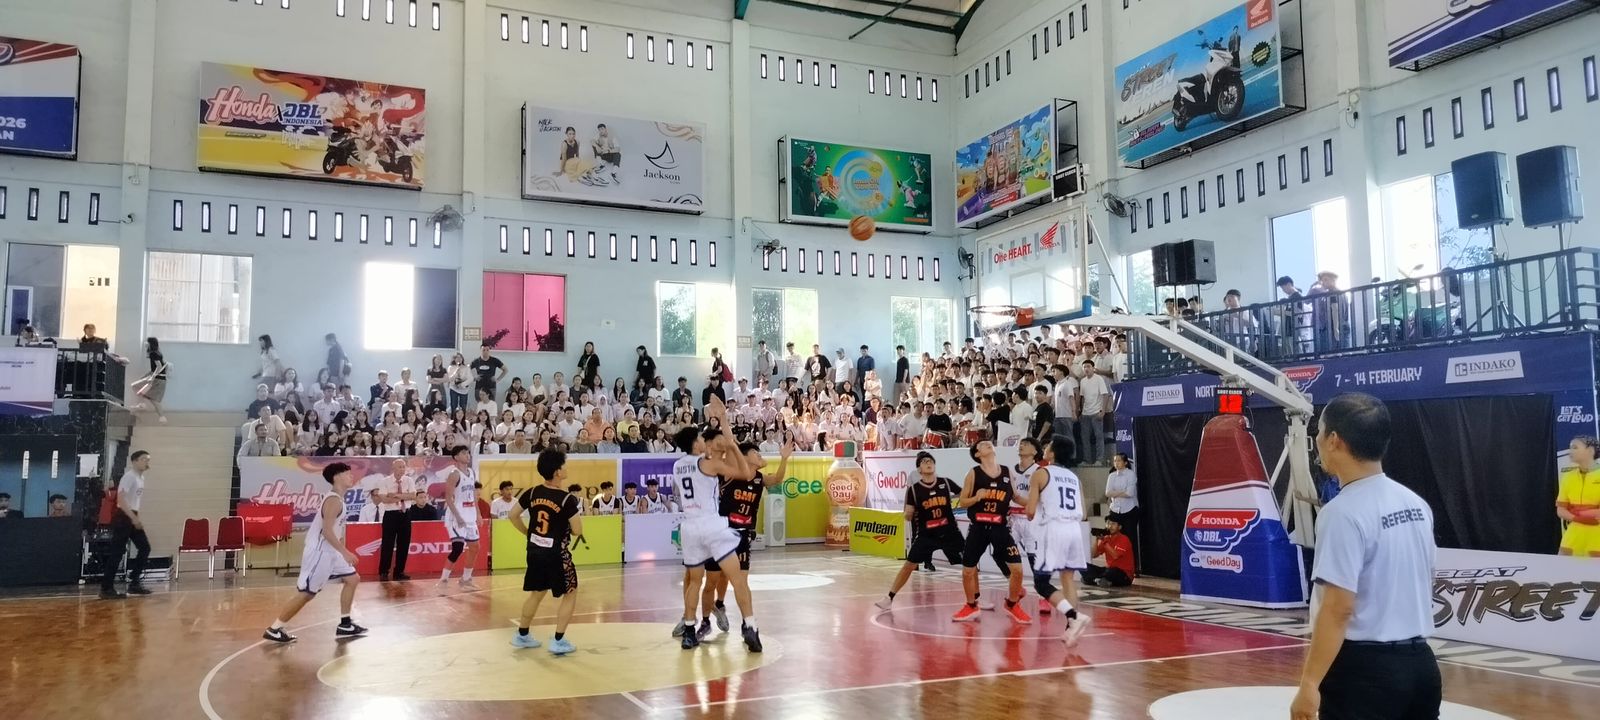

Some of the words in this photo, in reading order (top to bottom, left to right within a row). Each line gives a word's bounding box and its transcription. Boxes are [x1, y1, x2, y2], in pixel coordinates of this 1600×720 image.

[206, 86, 276, 123] Honda
[284, 103, 322, 118] DBL
[284, 118, 323, 126] INDONESIA
[643, 169, 681, 181] Jackson
[994, 252, 1008, 263] One
[1479, 359, 1526, 372] INDAKO
[1287, 370, 1312, 379] HONDA
[1335, 374, 1342, 388] 7
[1354, 372, 1366, 386] 14
[1369, 366, 1423, 385] FEBRUARY
[1154, 388, 1180, 398] INDAKO
[1195, 385, 1218, 399] NORT
[1560, 405, 1583, 415] LET'S
[676, 464, 696, 475] JUSTIN
[640, 473, 674, 488] UTR
[829, 482, 853, 491] Good
[877, 471, 900, 489] Good
[681, 477, 694, 499] 9
[783, 477, 823, 499] Cee
[985, 488, 1007, 502] MW
[252, 479, 321, 512] Honda
[344, 489, 366, 504] BL
[833, 491, 852, 500] Day
[1058, 486, 1076, 511] 15
[738, 503, 750, 515] 31
[922, 496, 947, 510] SMW
[931, 508, 942, 519] 10
[1381, 508, 1425, 530] REFEREE
[536, 510, 550, 535] 5
[854, 520, 898, 536] proteam
[1202, 517, 1241, 526] HONDA
[1203, 531, 1221, 543] DBL
[408, 542, 469, 555] OND
[1206, 556, 1225, 567] Good
[1226, 557, 1241, 570] Day
[1433, 566, 1528, 579] BEAT
[1432, 579, 1600, 628] STREET
